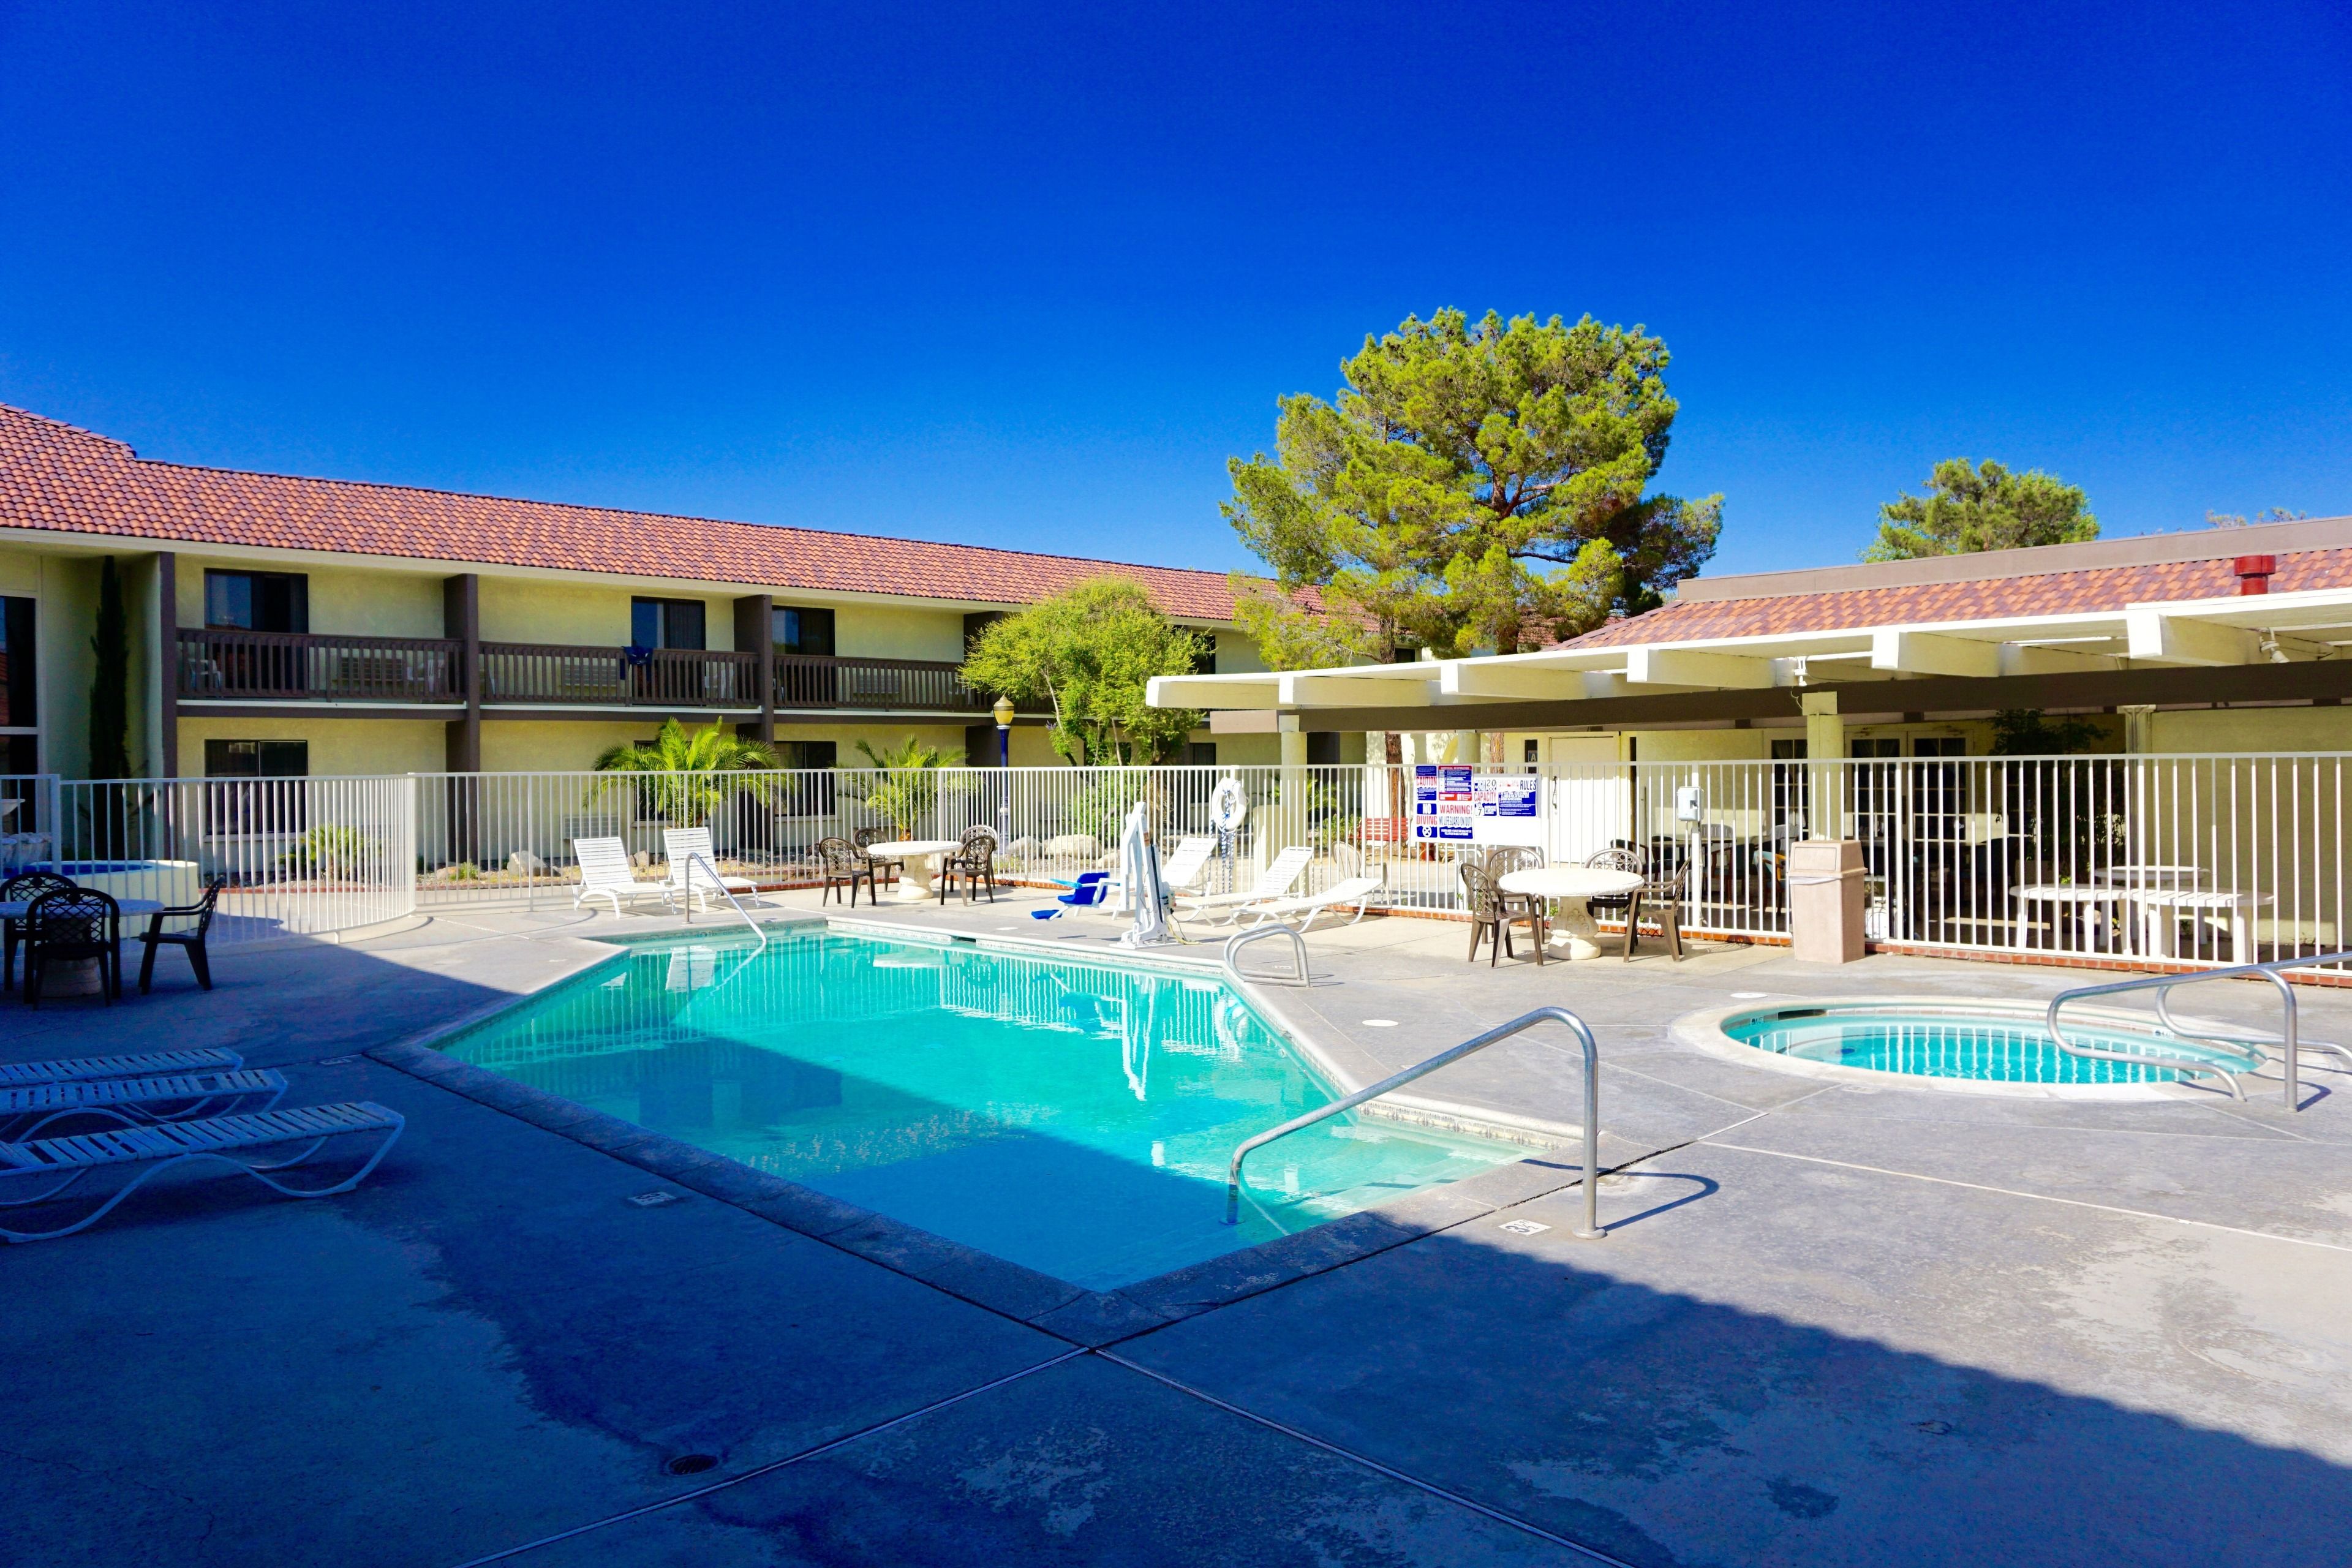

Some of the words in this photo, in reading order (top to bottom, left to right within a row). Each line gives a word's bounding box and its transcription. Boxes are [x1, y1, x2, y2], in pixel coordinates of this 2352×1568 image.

[1416, 777, 1437, 786] CAUTION
[1520, 780, 1537, 790] RULES
[1474, 792, 1496, 802] CAPACITY
[1422, 803, 1431, 815] NO
[1440, 804, 1472, 815] WARNING!
[1416, 815, 1438, 825] DIVING
[1439, 816, 1443, 825] NO
[1444, 816, 1460, 826] LIFEGUARD
[1460, 816, 1464, 826] ON
